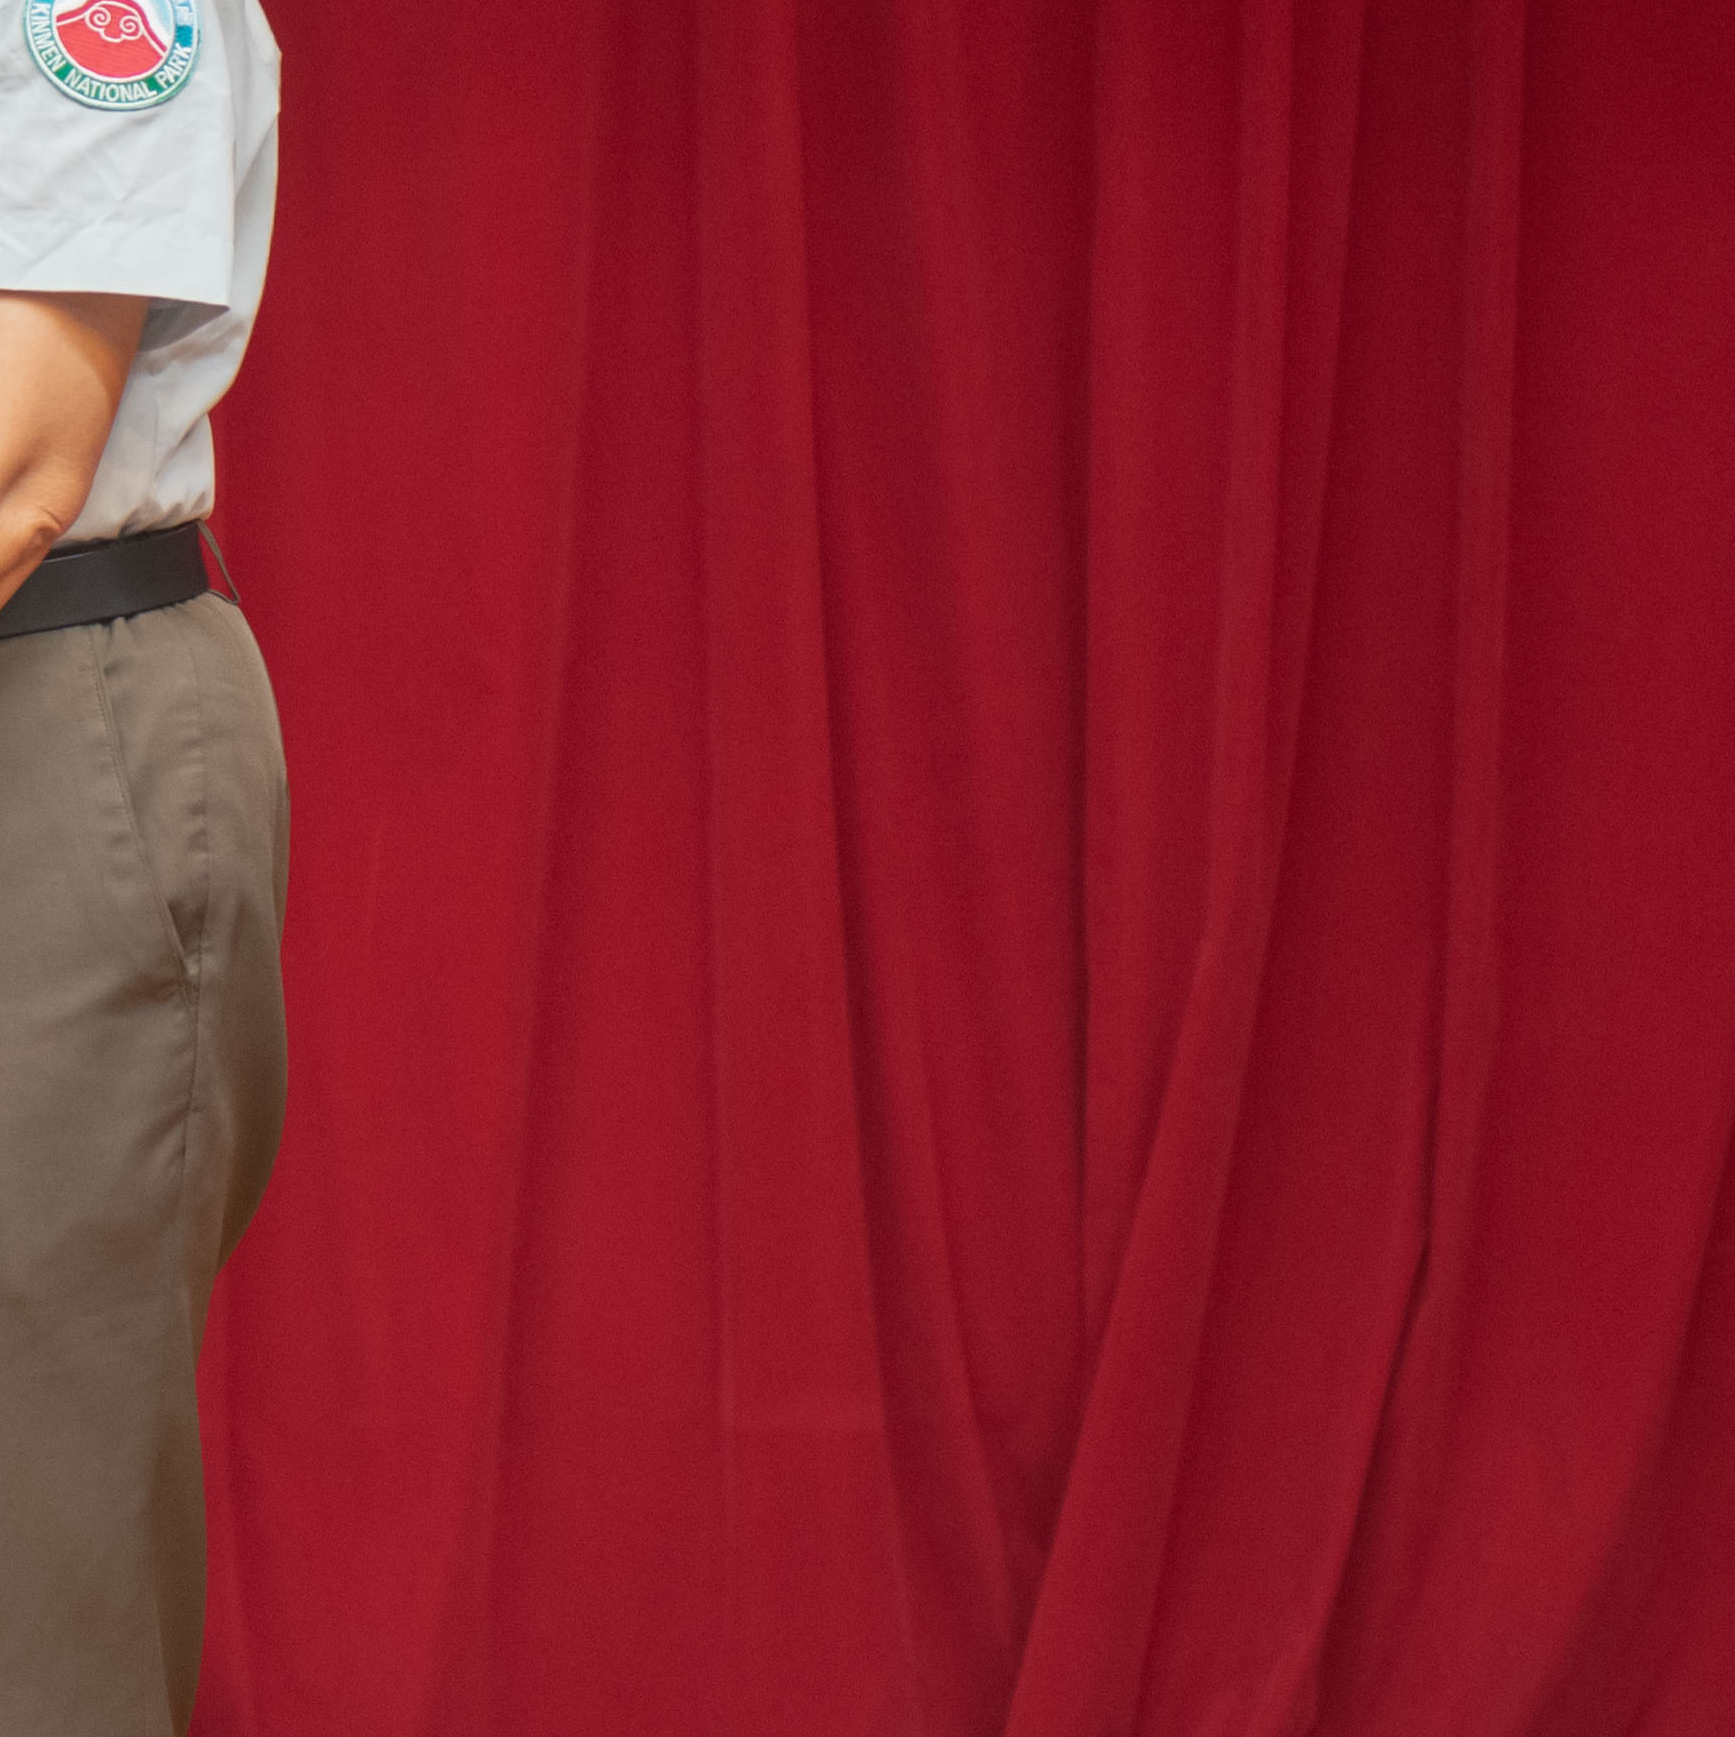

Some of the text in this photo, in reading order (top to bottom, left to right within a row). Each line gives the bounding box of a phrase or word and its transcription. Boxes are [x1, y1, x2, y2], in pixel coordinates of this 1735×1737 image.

[31, 3, 192, 102] KINMEN NATIONAL PARK
